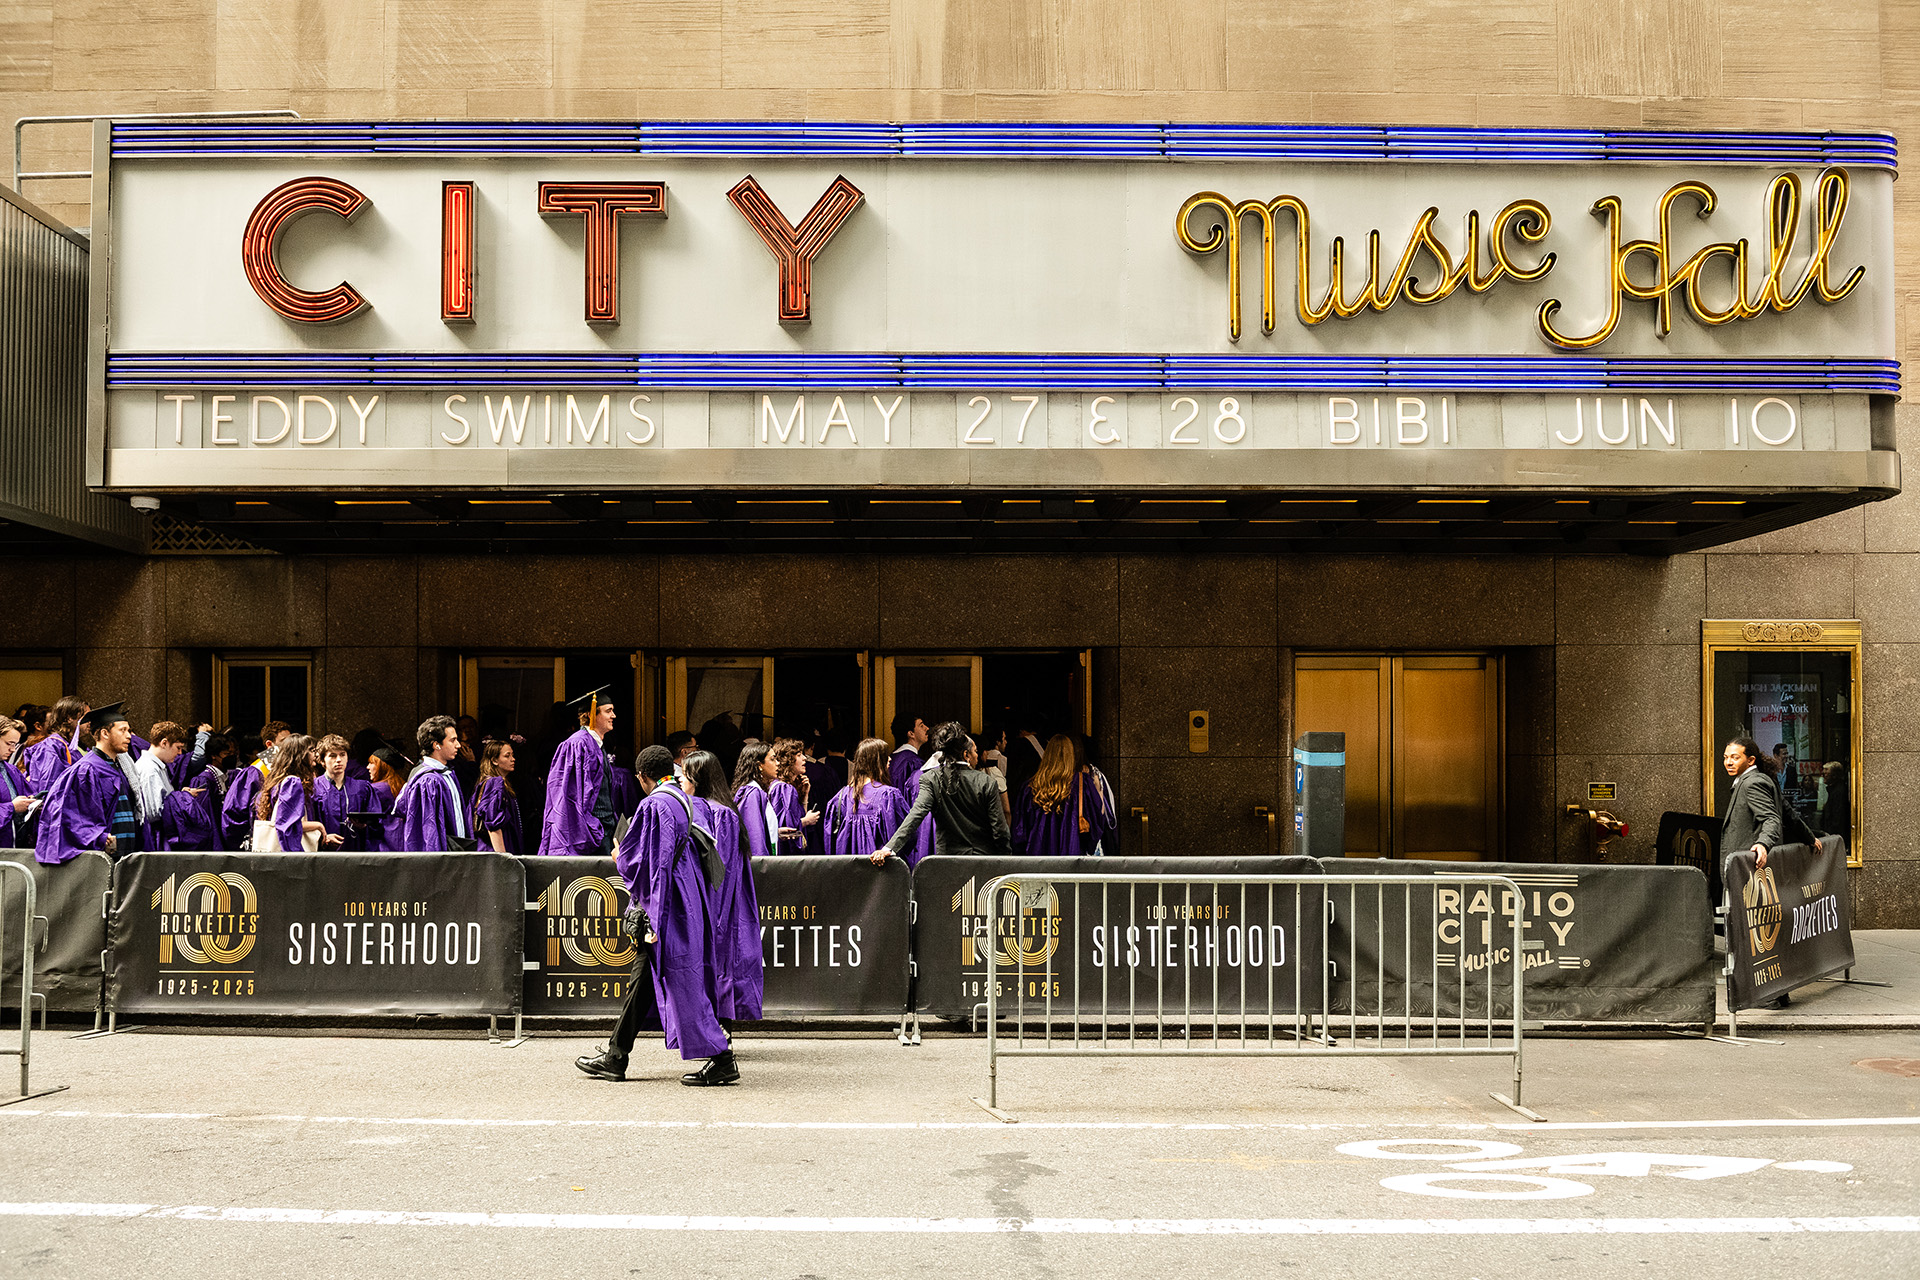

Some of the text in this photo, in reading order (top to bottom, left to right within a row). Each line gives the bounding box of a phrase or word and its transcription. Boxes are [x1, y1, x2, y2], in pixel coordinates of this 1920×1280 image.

[242, 174, 865, 326] CITY
[1174, 167, 1866, 350] Music Hall
[163, 395, 1798, 445] TEDDY SWIMS MAY 27 & 28 BIBI JUN 10
[1740, 684, 1818, 692] HUGH JACKMAN
[1780, 691, 1794, 702] Live
[1748, 704, 1809, 713] From New York
[1297, 767, 1303, 790] P
[1810, 882, 1825, 897] YEAR
[344, 902, 428, 917] 100 YEARS OF
[760, 905, 817, 920] YEARS OF
[1146, 905, 1230, 920] 100 YEARS OF
[1438, 889, 1575, 917] RADIO
[151, 872, 257, 964] 100
[161, 914, 257, 934] ROCKETTES
[547, 917, 622, 936] ROCKETT
[962, 917, 1060, 936] ROKETTES
[1791, 894, 1838, 944] ROCKETTES
[289, 922, 481, 965] SISTERHOOD
[760, 925, 862, 967] ETTES
[1092, 925, 1285, 967] SISTERHOOD
[1459, 947, 1510, 973] MUSIC
[159, 979, 254, 996] 1925-2025
[547, 981, 630, 997] 1925-20
